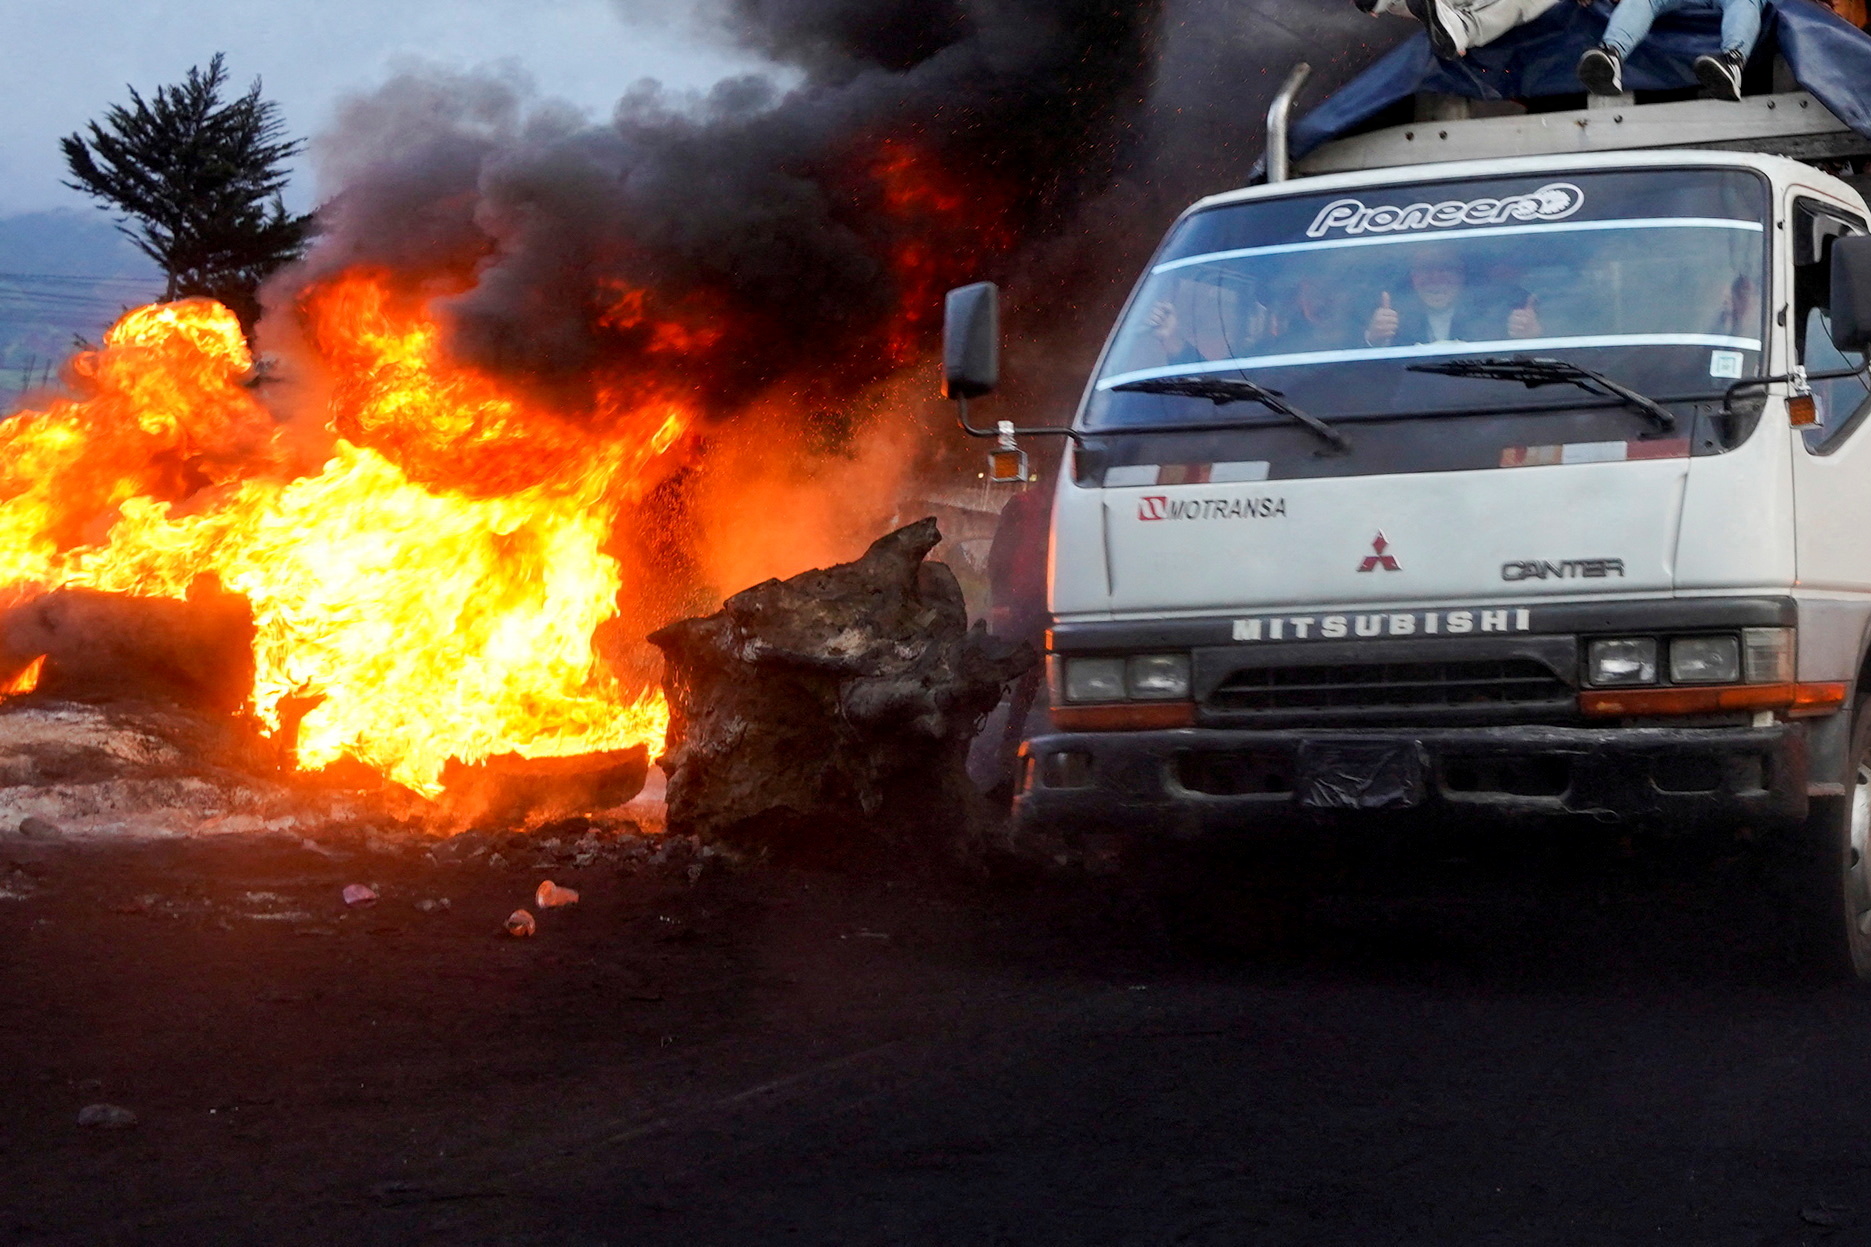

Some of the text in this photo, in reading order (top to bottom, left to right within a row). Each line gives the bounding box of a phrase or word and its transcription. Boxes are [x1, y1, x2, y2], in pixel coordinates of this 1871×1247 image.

[1306, 192, 1546, 238] Pioneer
[1167, 497, 1287, 520] MOTRANSA
[1502, 558, 1625, 581] CANTER
[1232, 608, 1531, 641] MITSUBISHI
